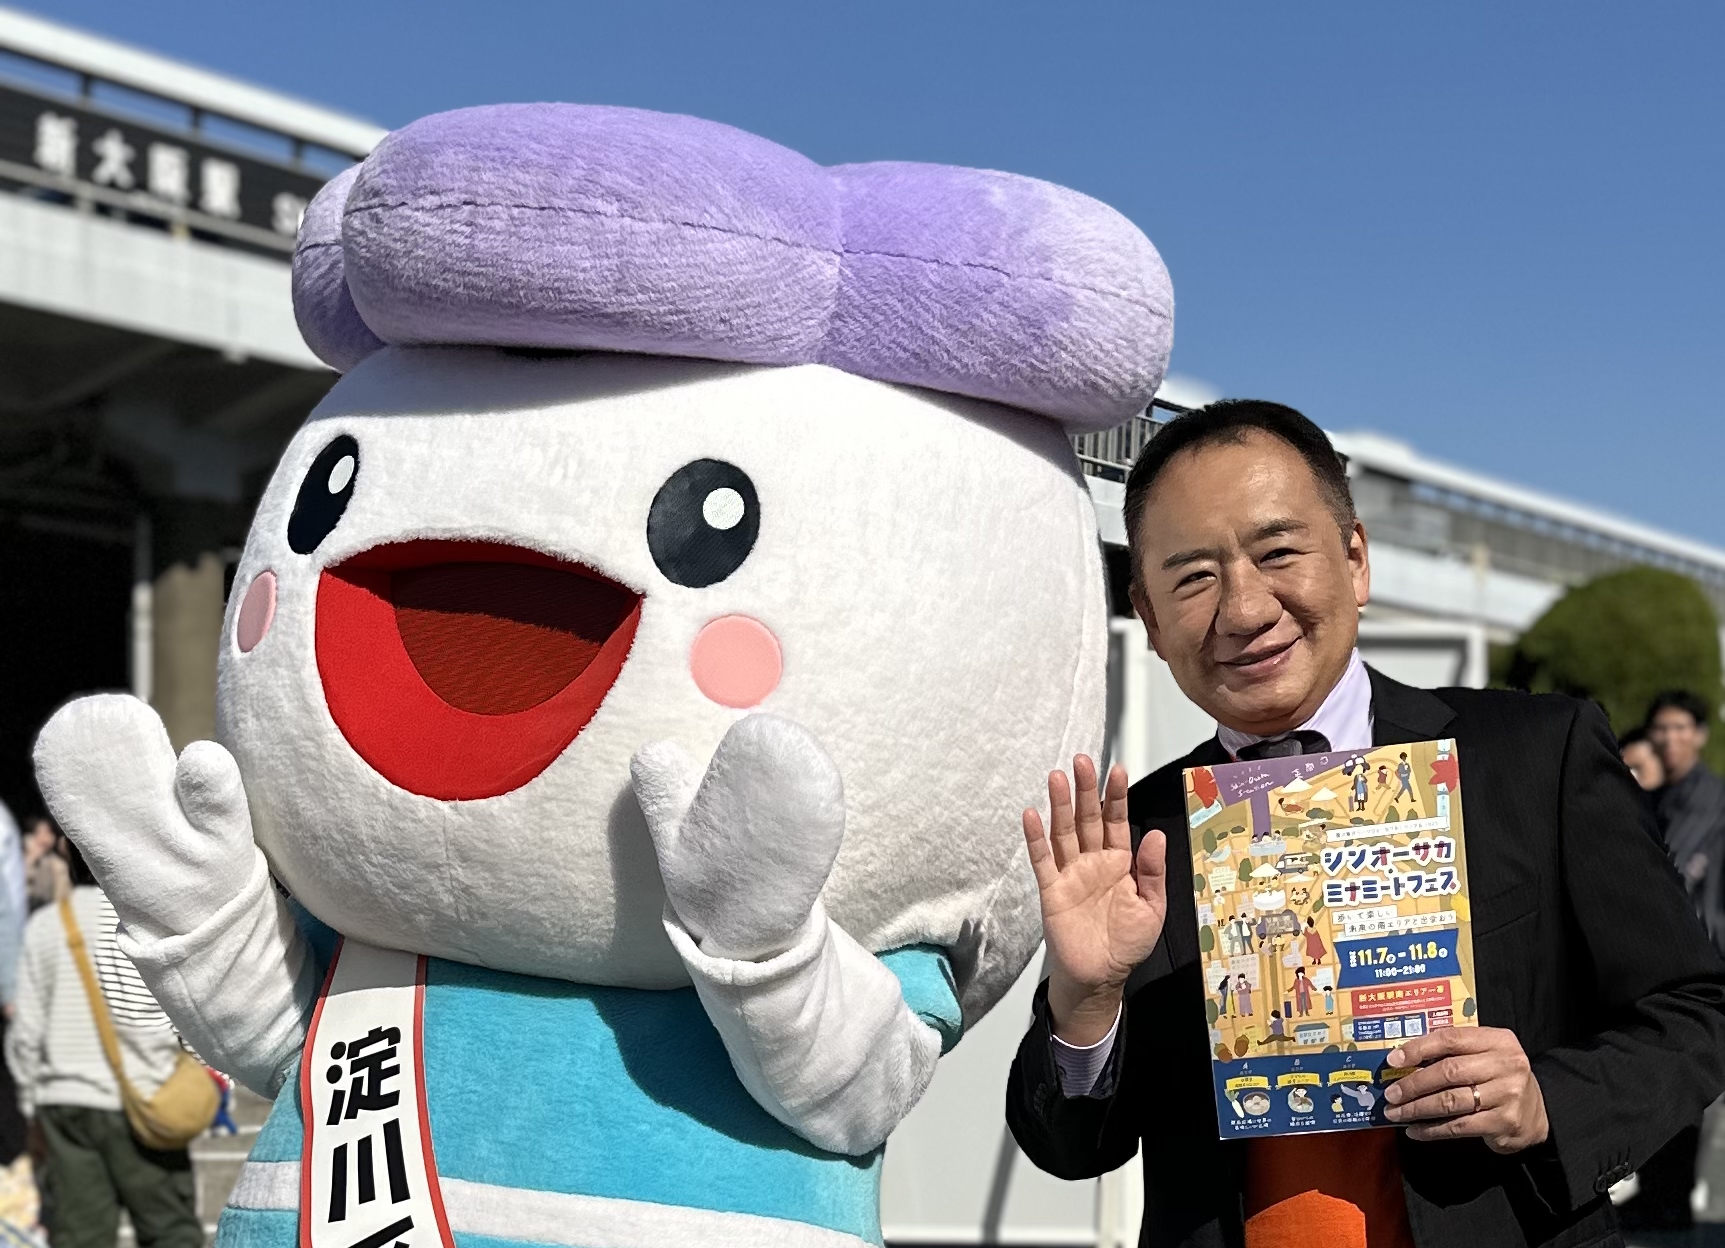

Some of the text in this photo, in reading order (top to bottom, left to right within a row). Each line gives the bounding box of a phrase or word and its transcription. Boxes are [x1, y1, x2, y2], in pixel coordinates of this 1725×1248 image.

[1324, 841, 1451, 872] シンオーサカ
[1326, 871, 1456, 903] ミナミートフェス
